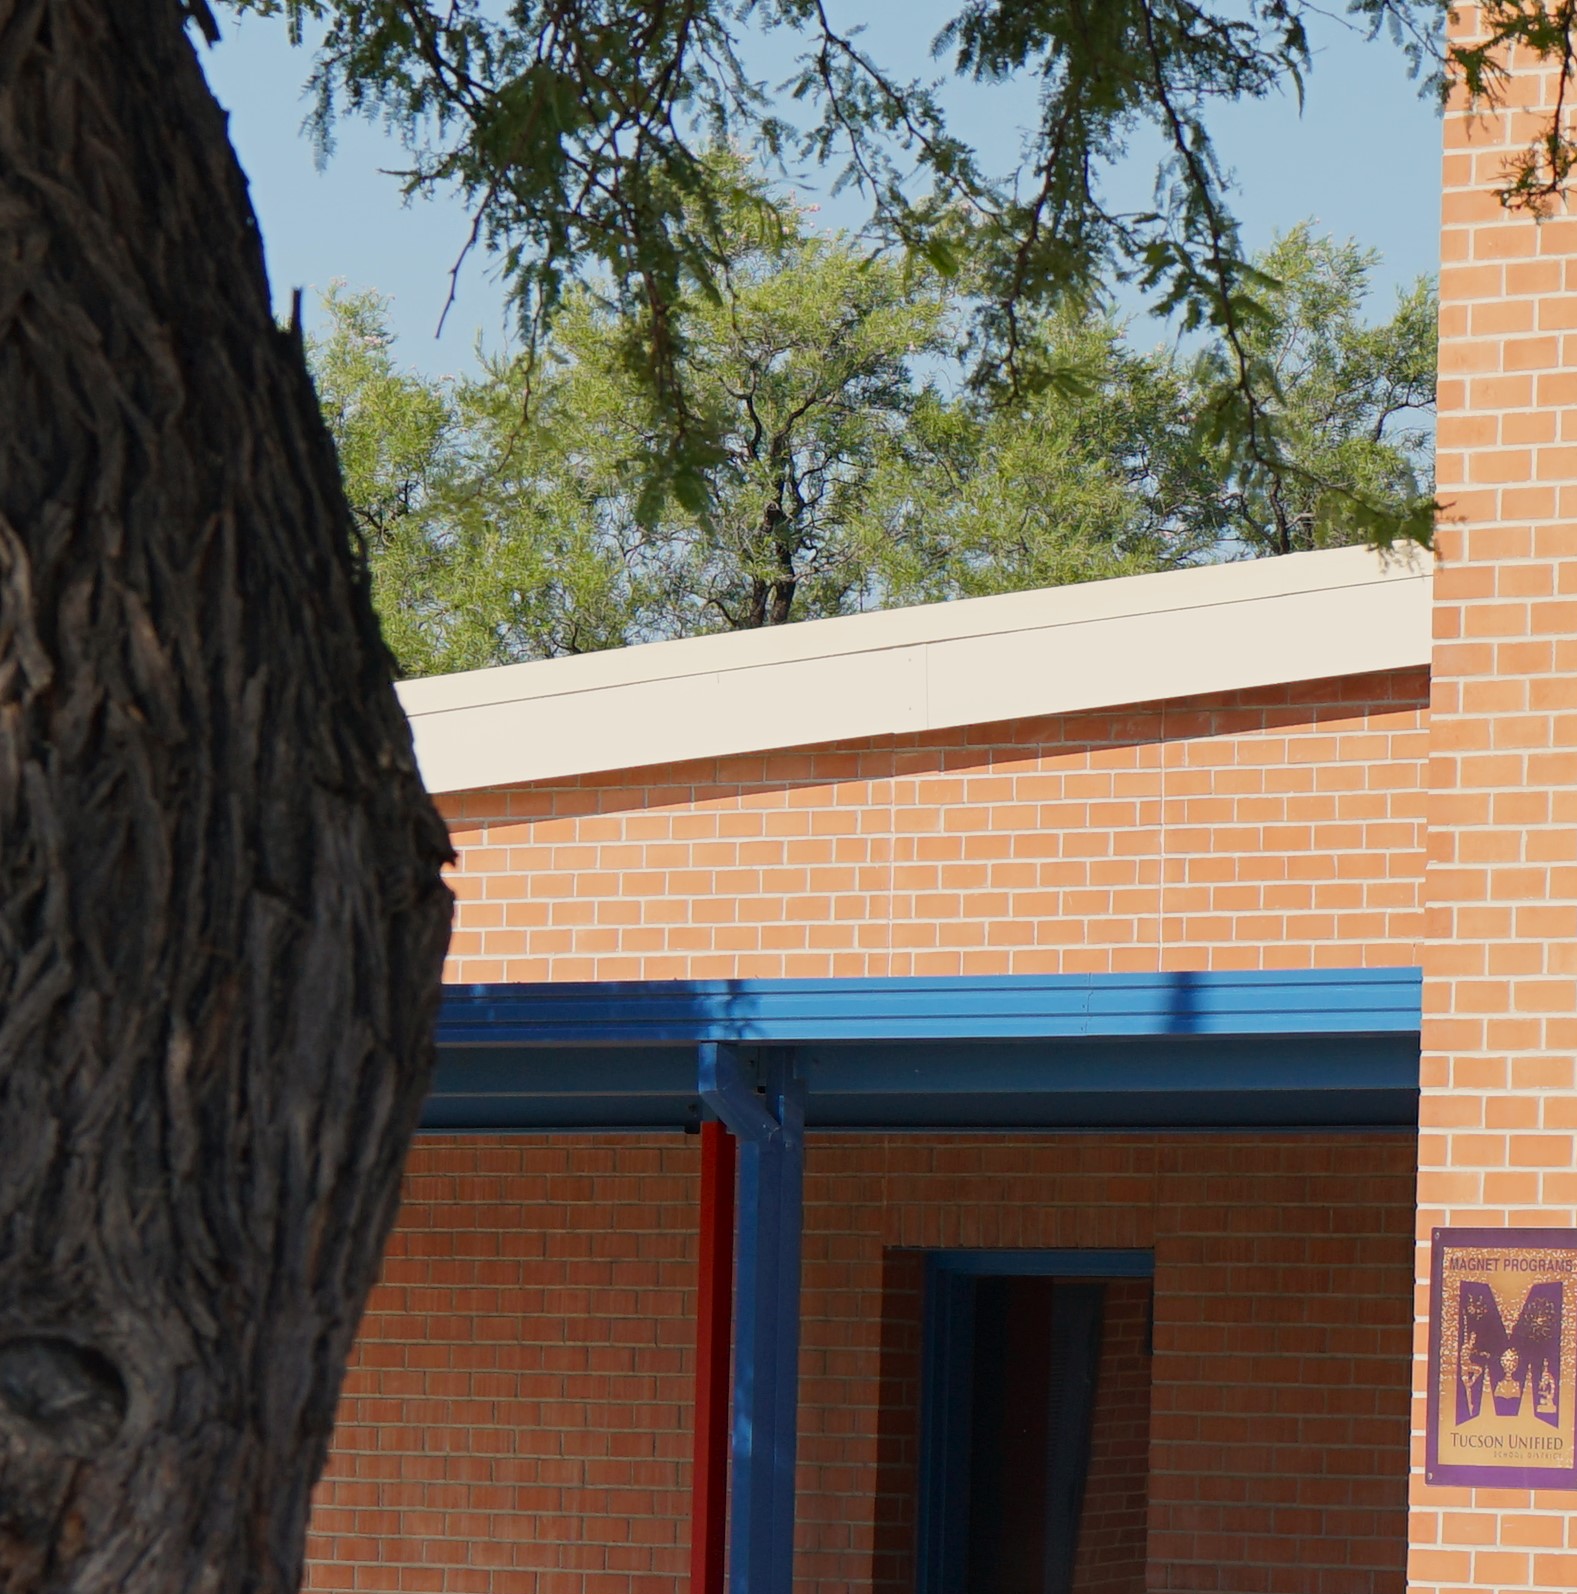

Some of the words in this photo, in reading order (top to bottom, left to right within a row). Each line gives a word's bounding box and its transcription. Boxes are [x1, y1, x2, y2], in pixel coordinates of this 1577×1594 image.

[1449, 1257, 1500, 1272] MAGNET
[1503, 1258, 1573, 1272] PROGRAMS
[1450, 1432, 1503, 1448] TUCSON
[1508, 1434, 1563, 1451] UNIFIED
